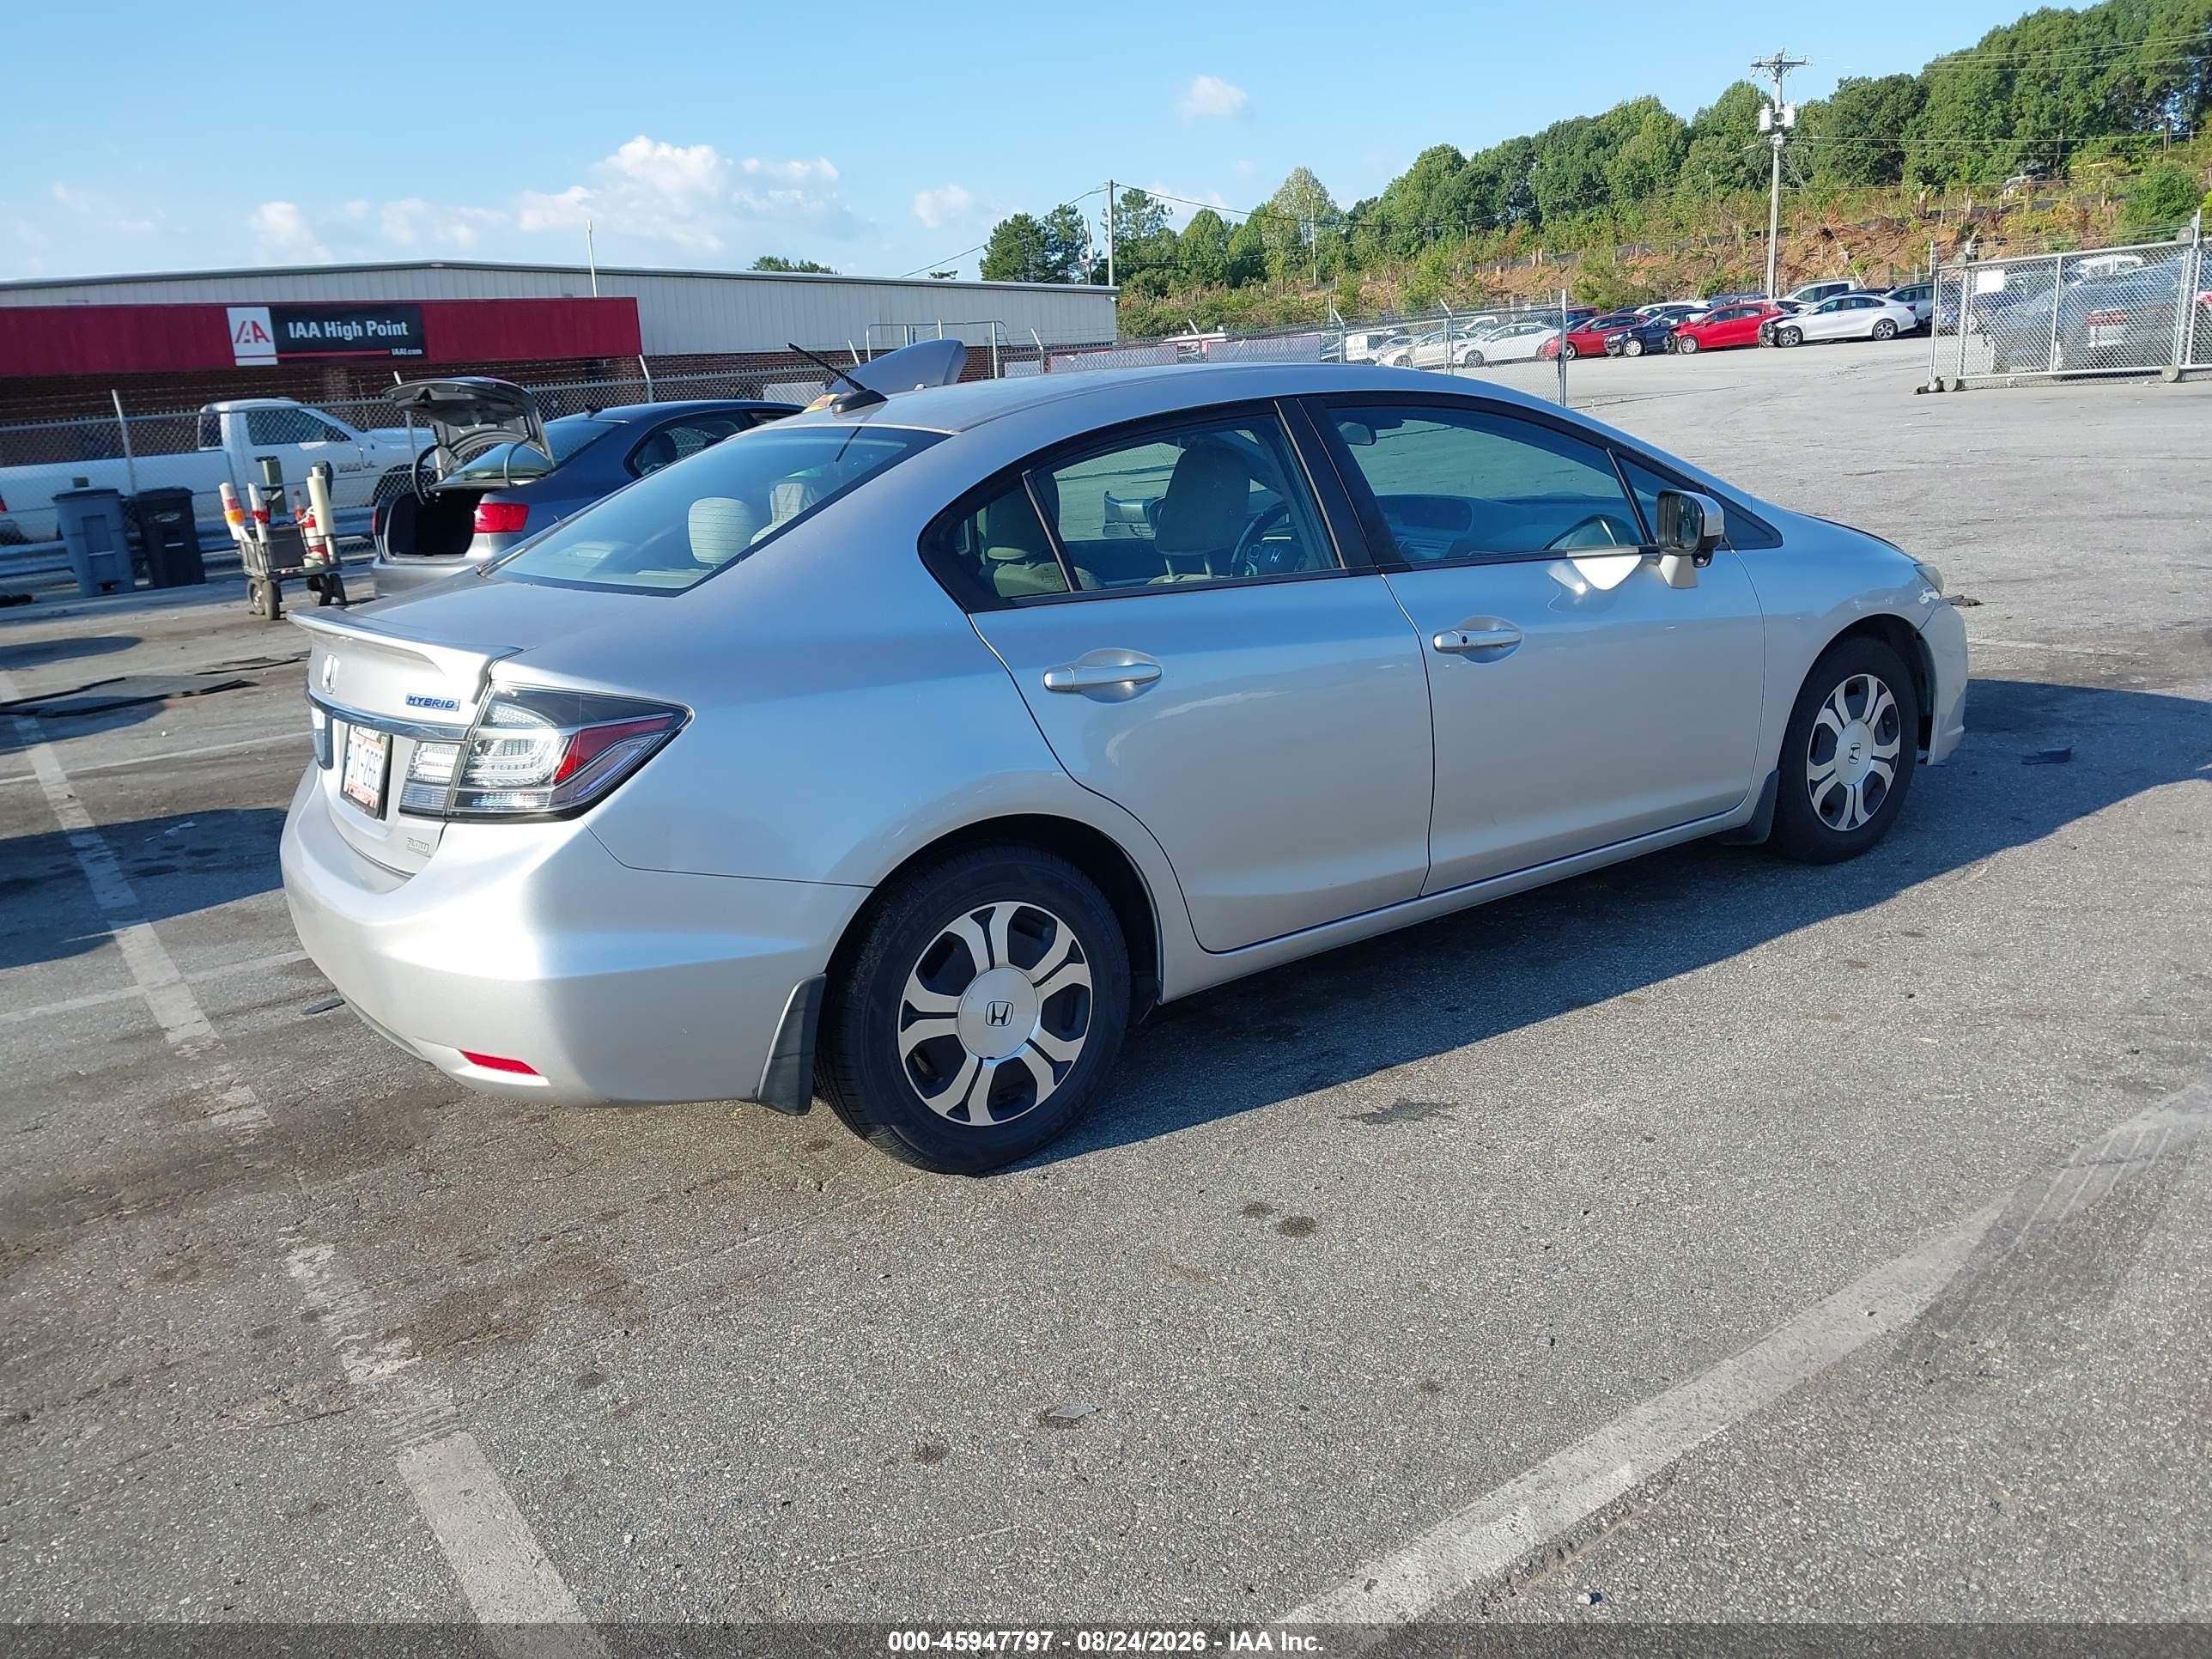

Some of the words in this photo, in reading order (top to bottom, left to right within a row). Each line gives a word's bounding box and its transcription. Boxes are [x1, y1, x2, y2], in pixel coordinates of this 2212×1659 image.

[288, 321, 321, 338] IAA
[324, 320, 362, 341] High
[366, 319, 409, 337] Point
[408, 695, 455, 708] HYBRID
